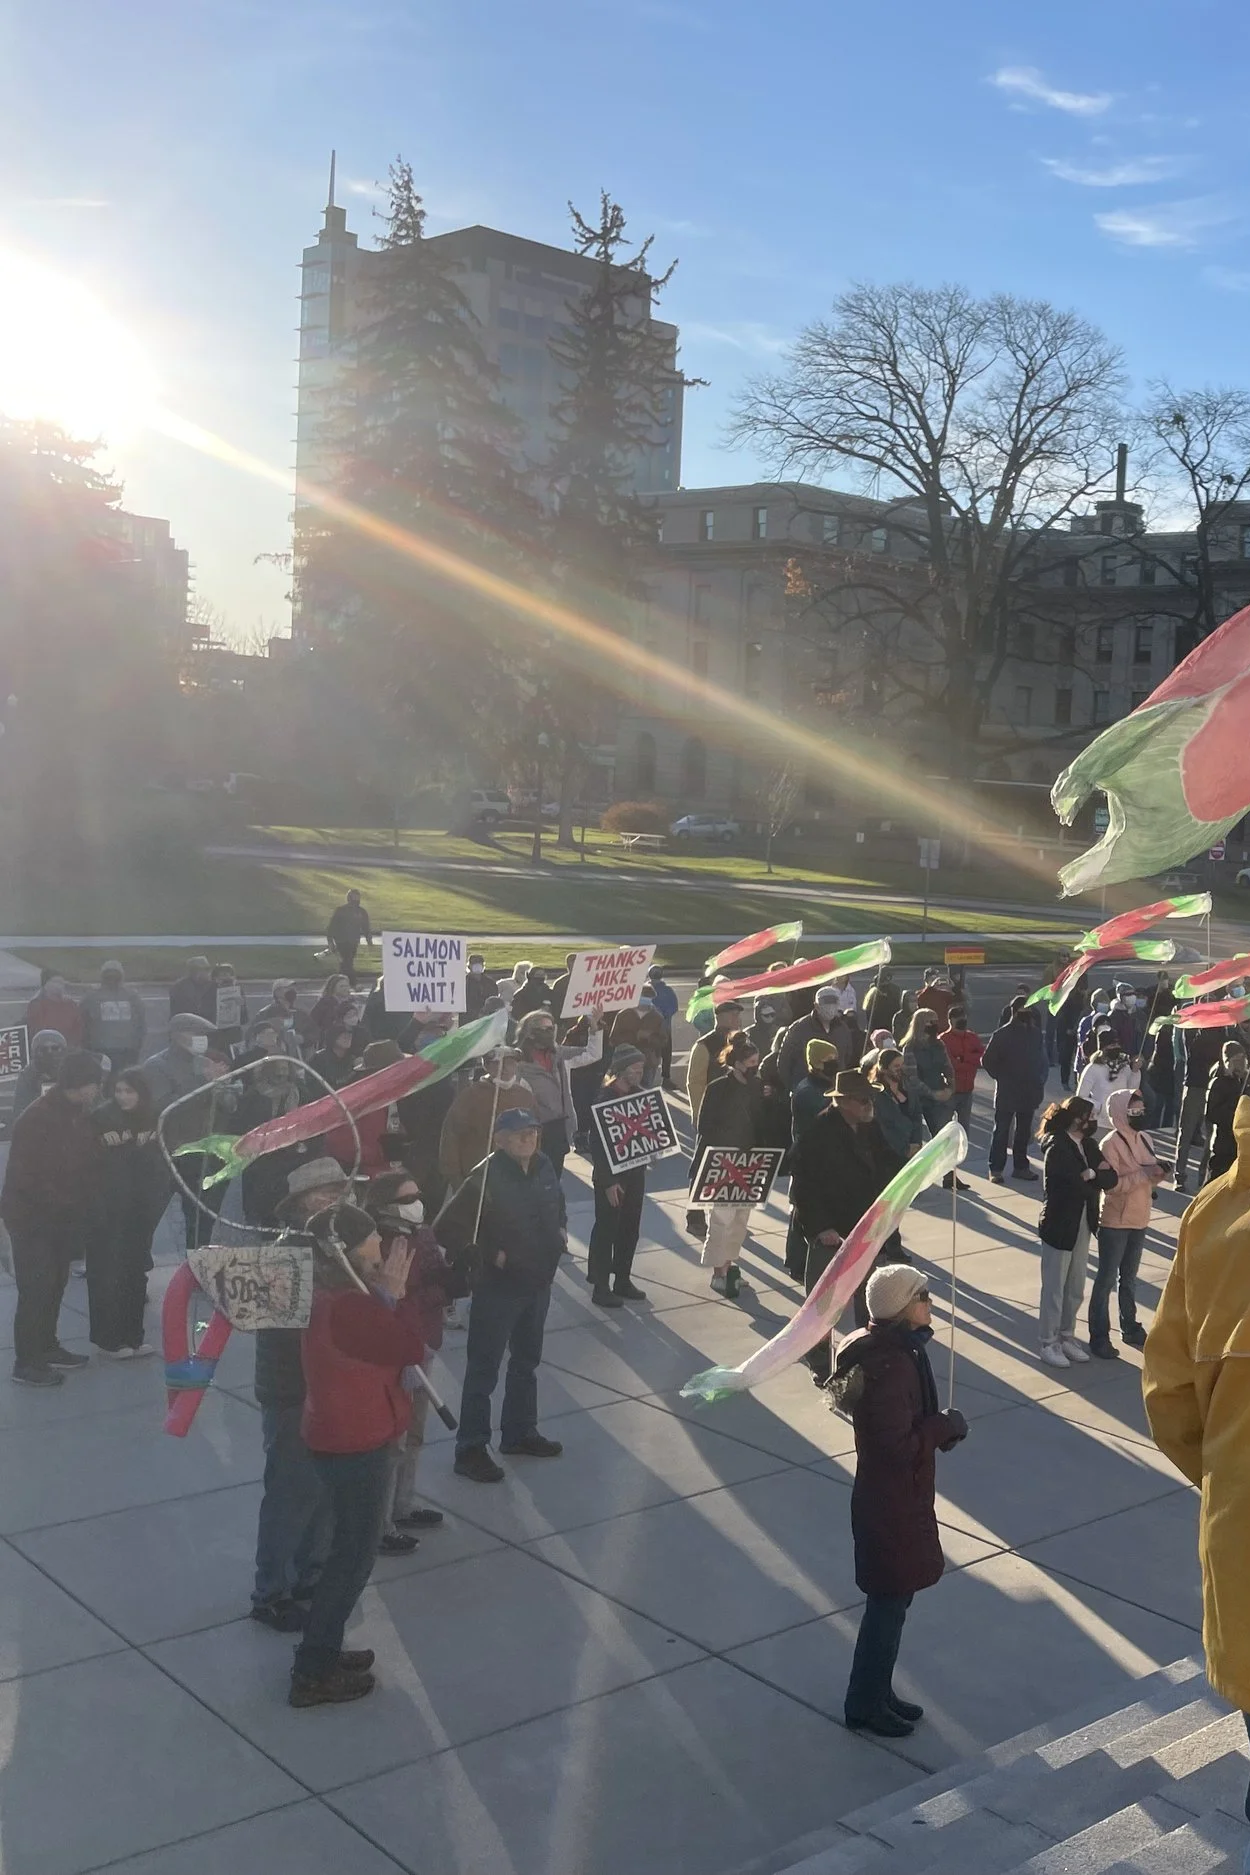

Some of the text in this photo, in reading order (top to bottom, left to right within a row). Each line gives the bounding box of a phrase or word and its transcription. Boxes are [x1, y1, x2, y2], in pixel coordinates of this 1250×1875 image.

[392, 937, 461, 960] SALMON
[407, 960, 448, 978] CAN'T
[584, 949, 647, 972] THANKS
[592, 968, 632, 988] MIKE
[407, 982, 455, 1004] WAIT!
[572, 984, 637, 1008] SIMPSON
[603, 1094, 659, 1124] SNAKE
[614, 1130, 671, 1162] DAMS
[711, 1152, 774, 1168] SNAKE
[699, 1185, 763, 1201] DAMS
